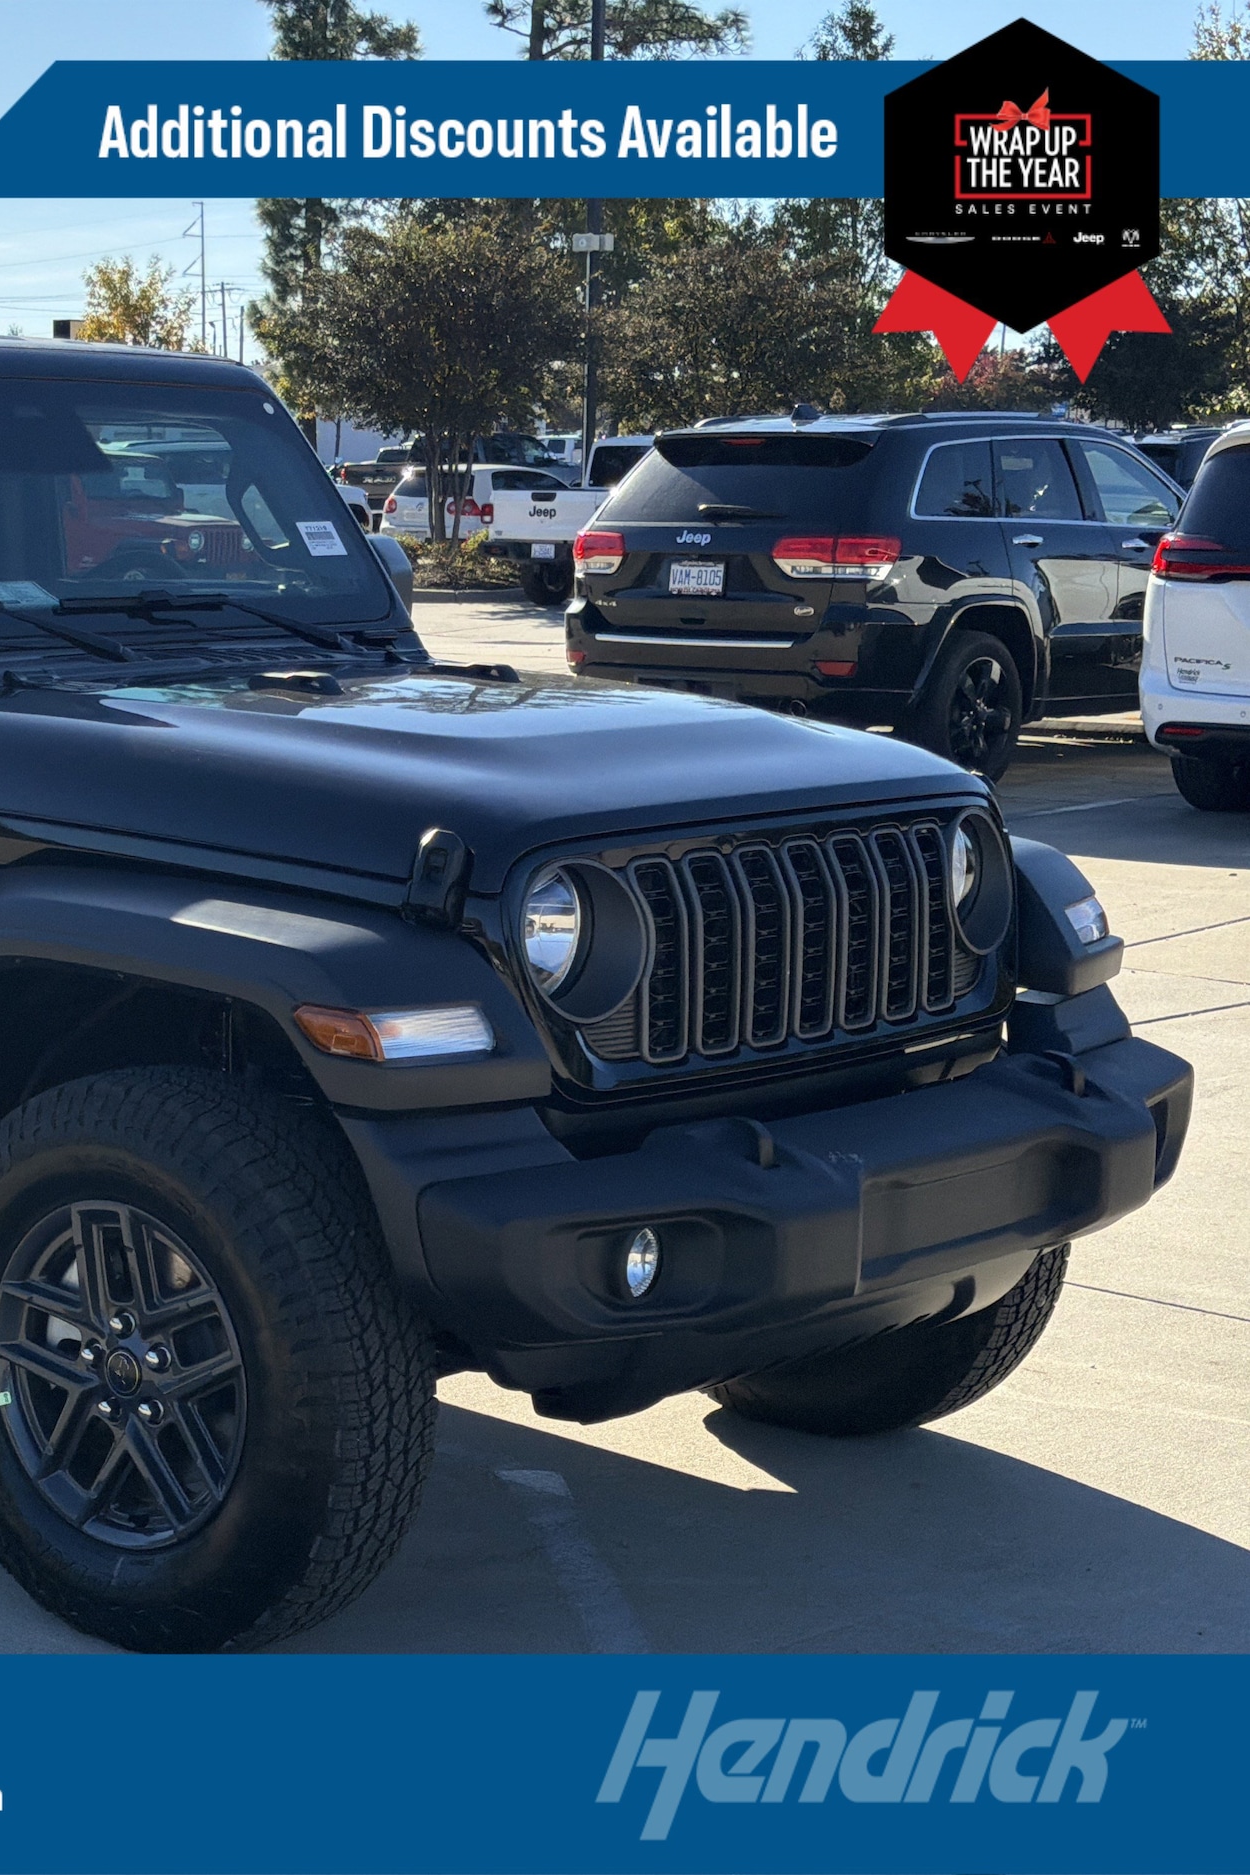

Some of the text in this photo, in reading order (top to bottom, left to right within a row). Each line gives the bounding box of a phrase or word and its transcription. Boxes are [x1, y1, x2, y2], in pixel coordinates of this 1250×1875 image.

[529, 506, 557, 519] Jeep
[676, 530, 712, 546] Jeep
[672, 569, 723, 586] VAM-8105
[1174, 656, 1224, 666] PACIFICA
